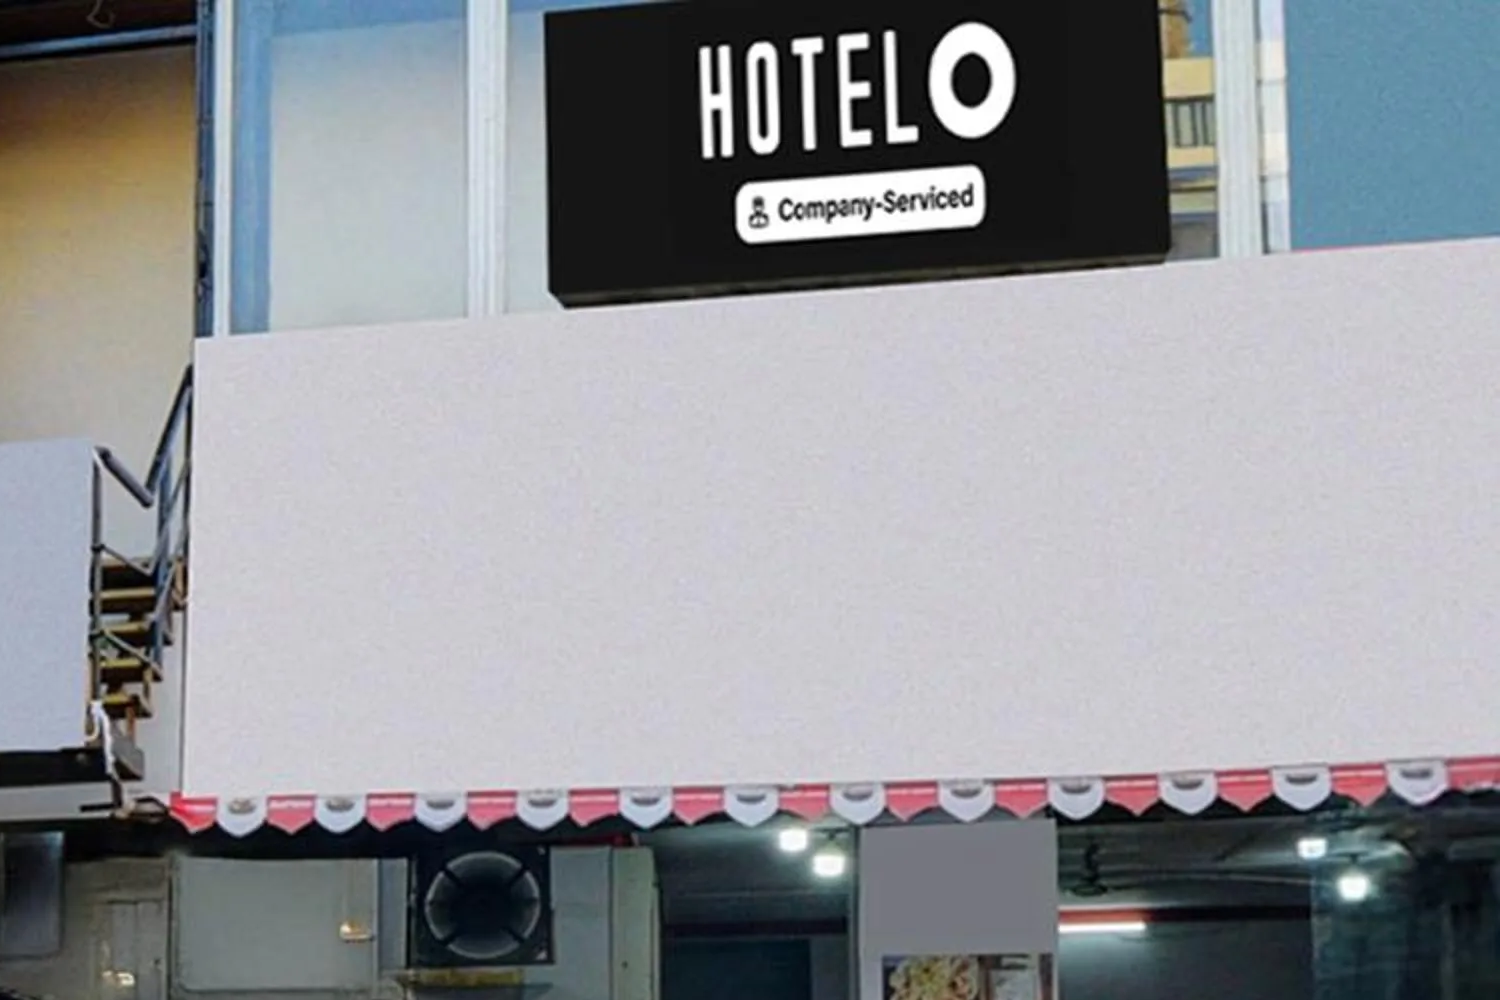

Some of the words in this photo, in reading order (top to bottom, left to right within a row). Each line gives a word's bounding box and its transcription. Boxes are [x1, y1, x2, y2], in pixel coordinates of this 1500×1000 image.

[699, 30, 919, 159] HOTEL
[928, 22, 1016, 139] O
[778, 183, 974, 224] Company-Serviced
